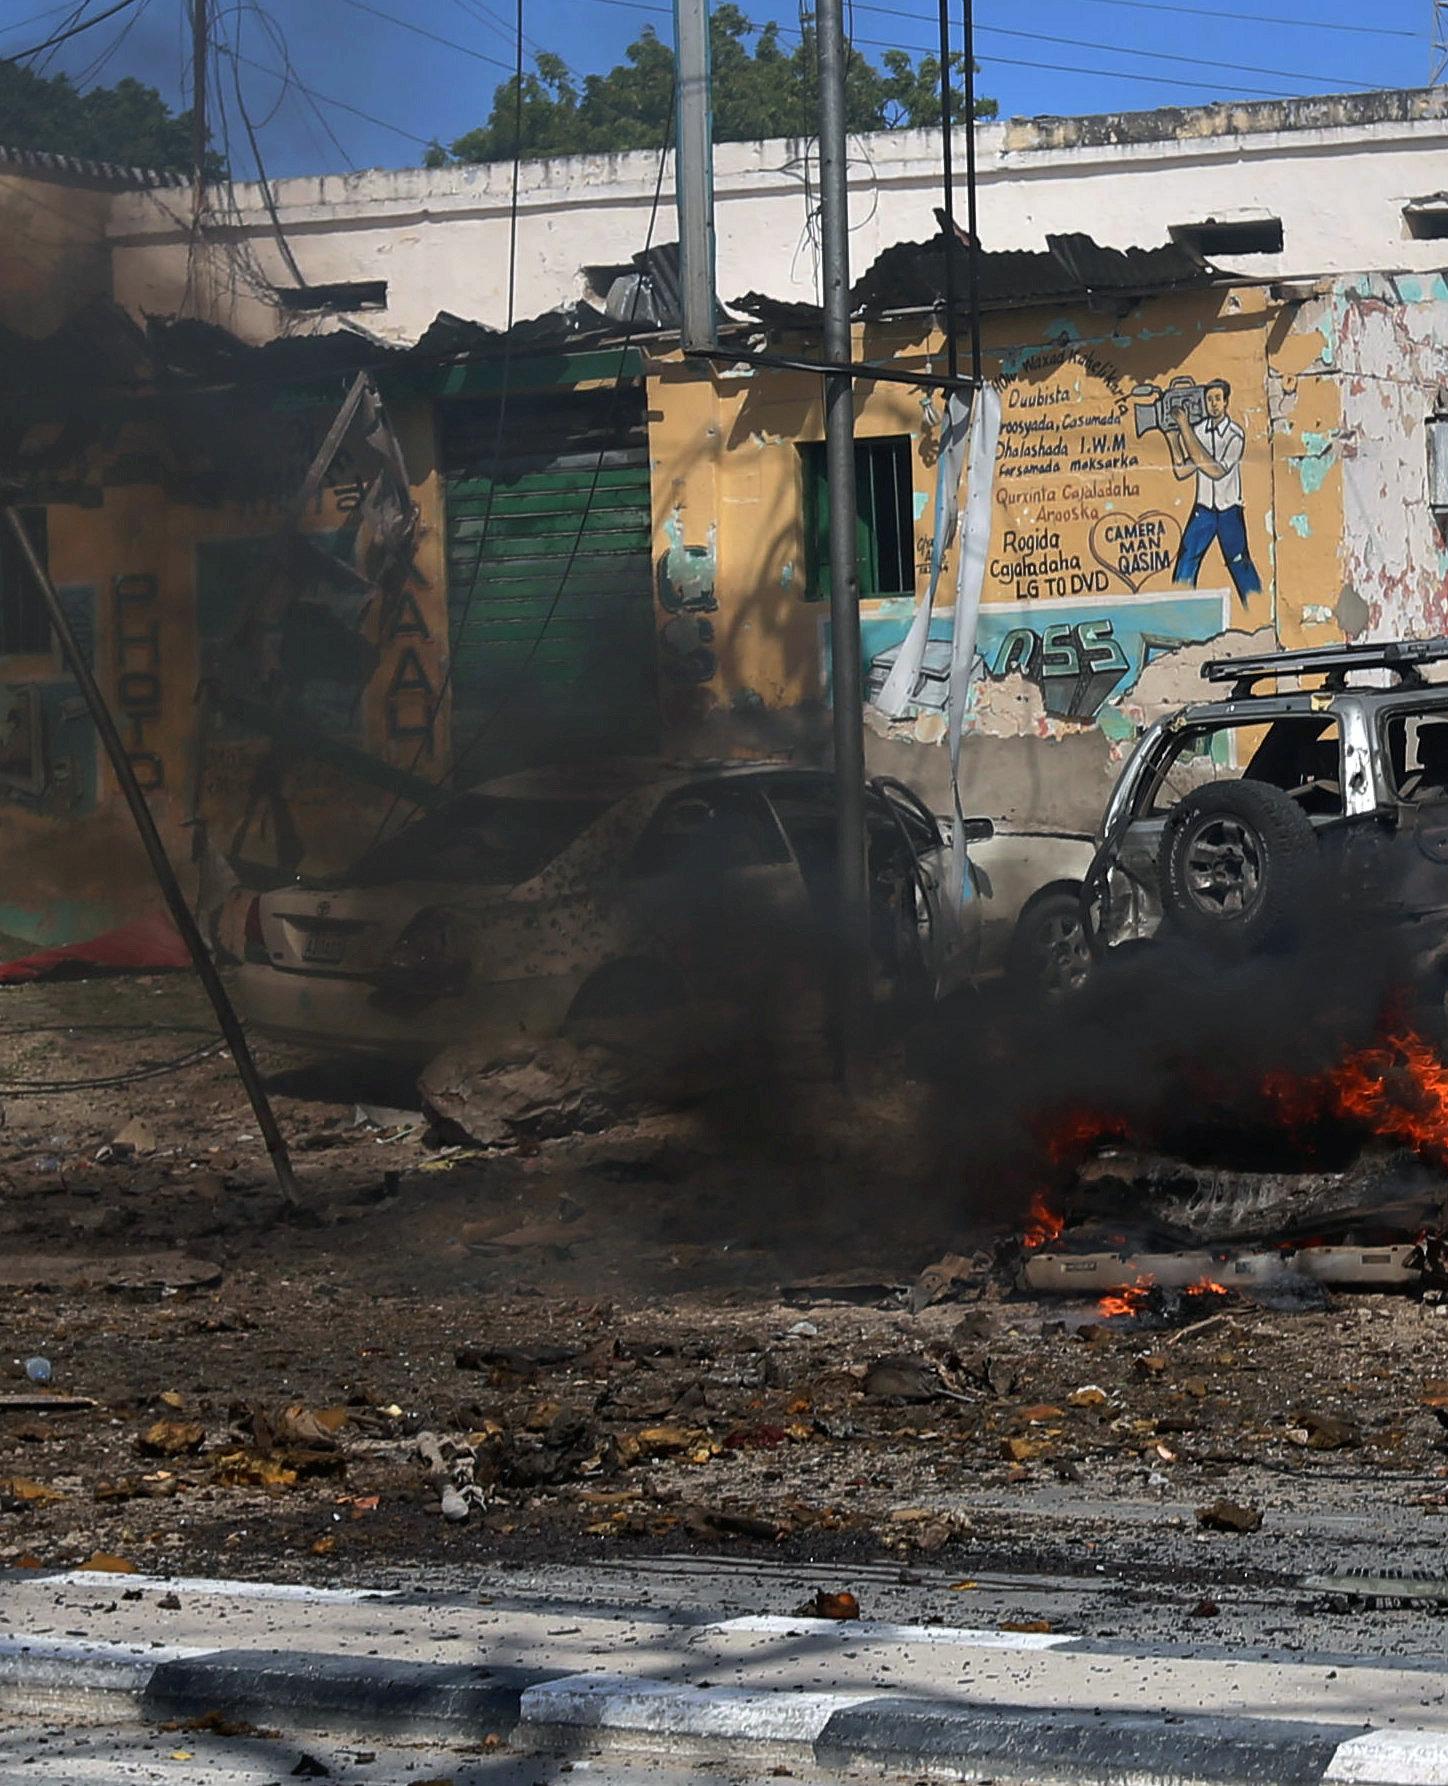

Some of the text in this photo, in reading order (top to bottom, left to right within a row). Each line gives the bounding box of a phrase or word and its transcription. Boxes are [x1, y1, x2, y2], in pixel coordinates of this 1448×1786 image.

[1008, 385, 1070, 408] Duubista
[998, 413, 1060, 439] roosyada,
[996, 484, 1056, 510] Qurxinta
[1035, 502, 1099, 523] Arooska
[1003, 527, 1061, 557] Rogida
[1104, 519, 1167, 543] CAMERA
[1119, 537, 1161, 554] MAN
[1118, 550, 1172, 577] QASIM
[1016, 579, 1040, 600] LG
[1071, 569, 1109, 595] DVD
